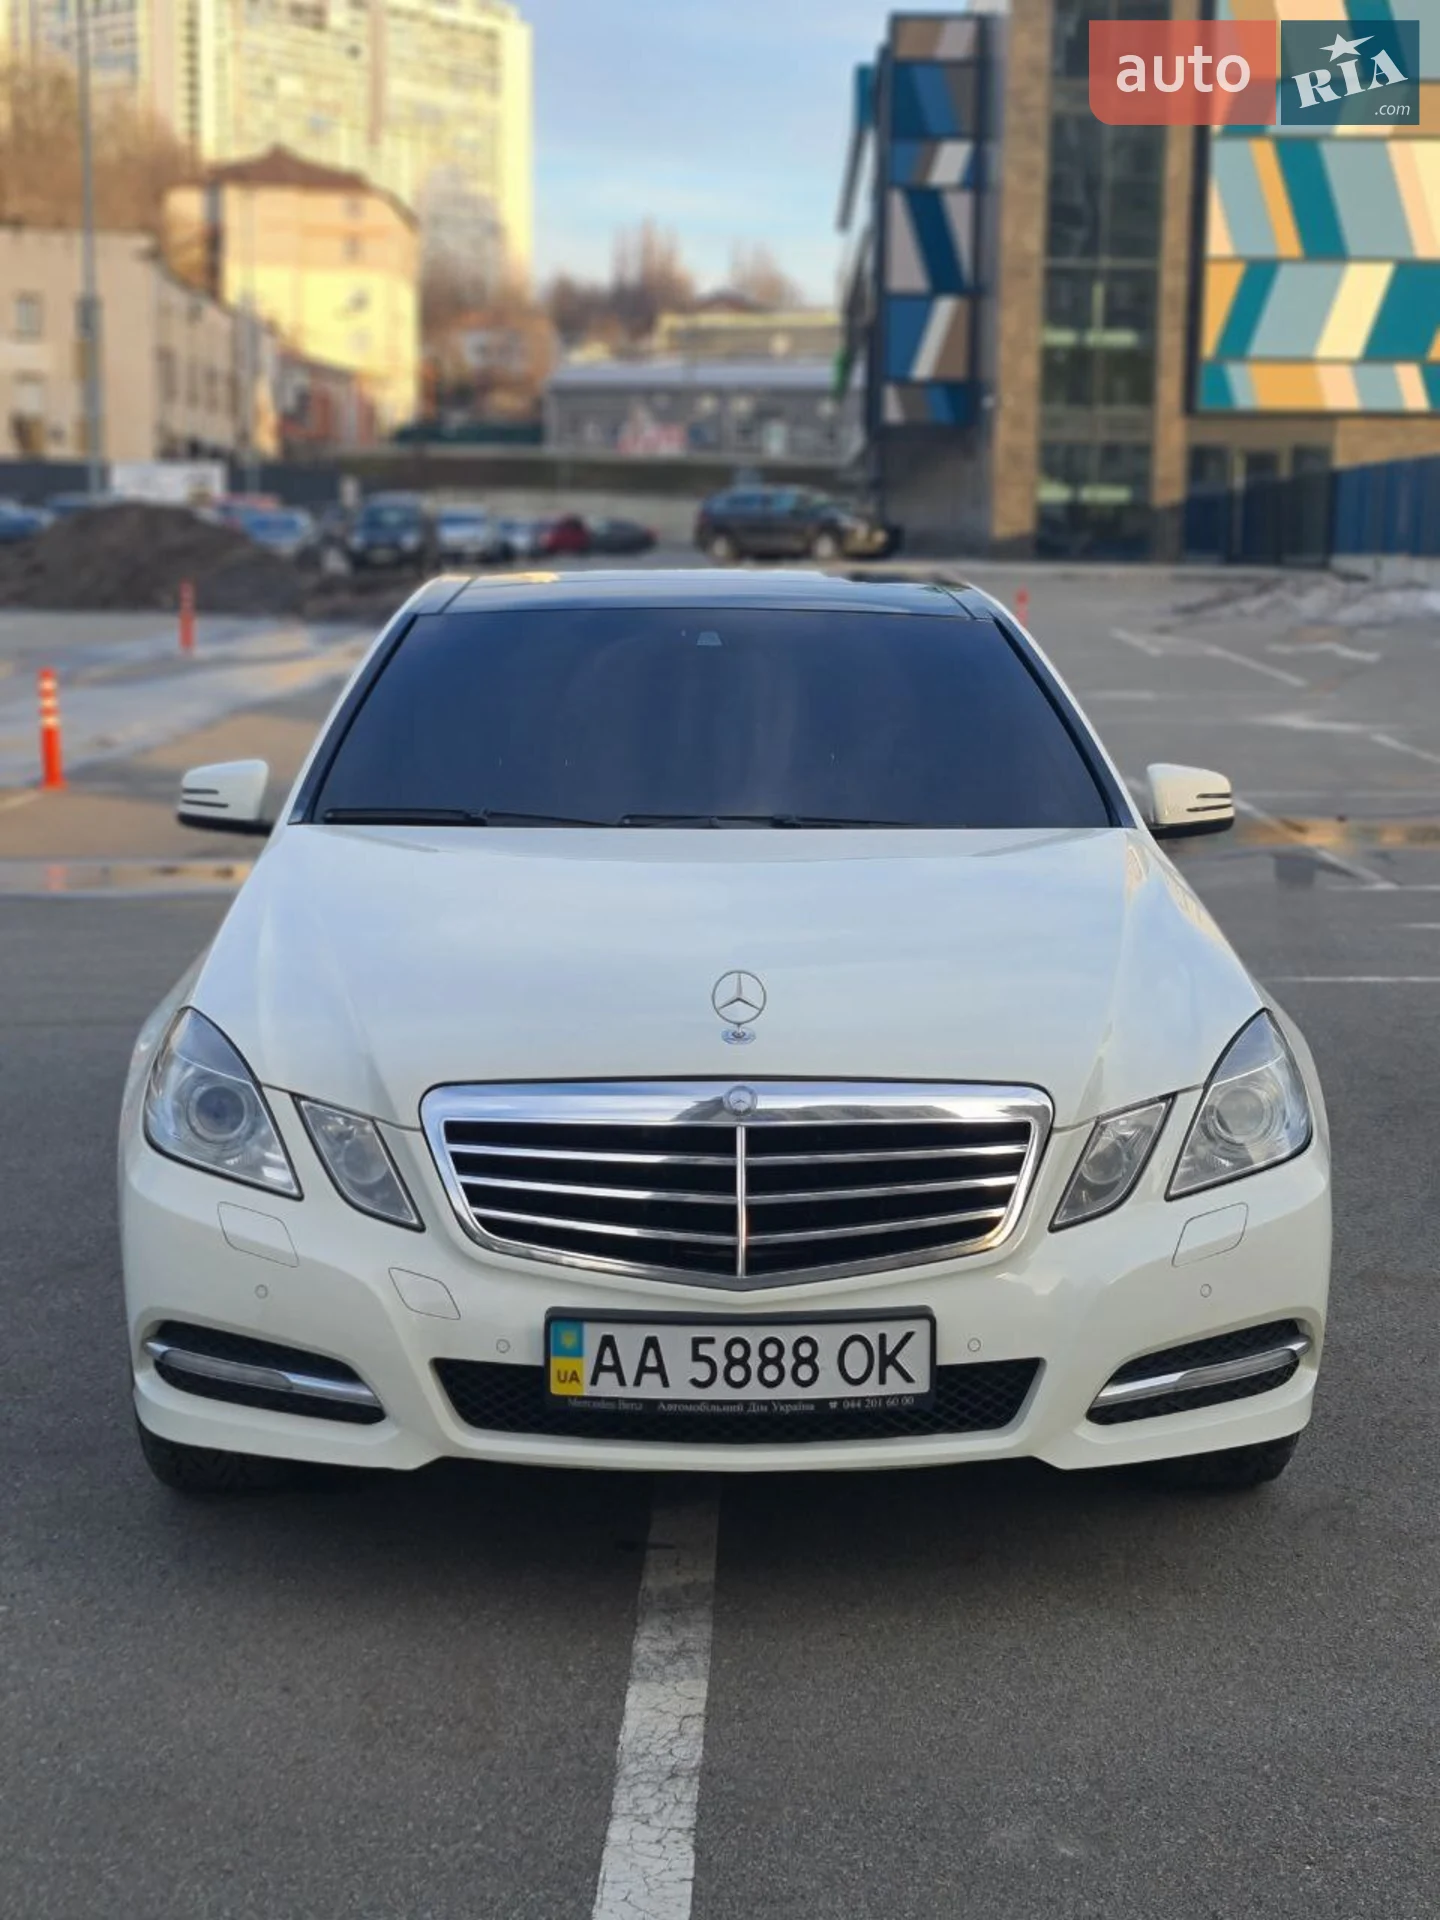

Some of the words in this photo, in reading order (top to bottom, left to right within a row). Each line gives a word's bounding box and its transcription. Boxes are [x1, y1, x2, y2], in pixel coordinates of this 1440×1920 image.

[556, 1368, 581, 1385] UA
[589, 1333, 671, 1389] AA
[688, 1335, 820, 1390] 5888
[836, 1330, 916, 1387] OK
